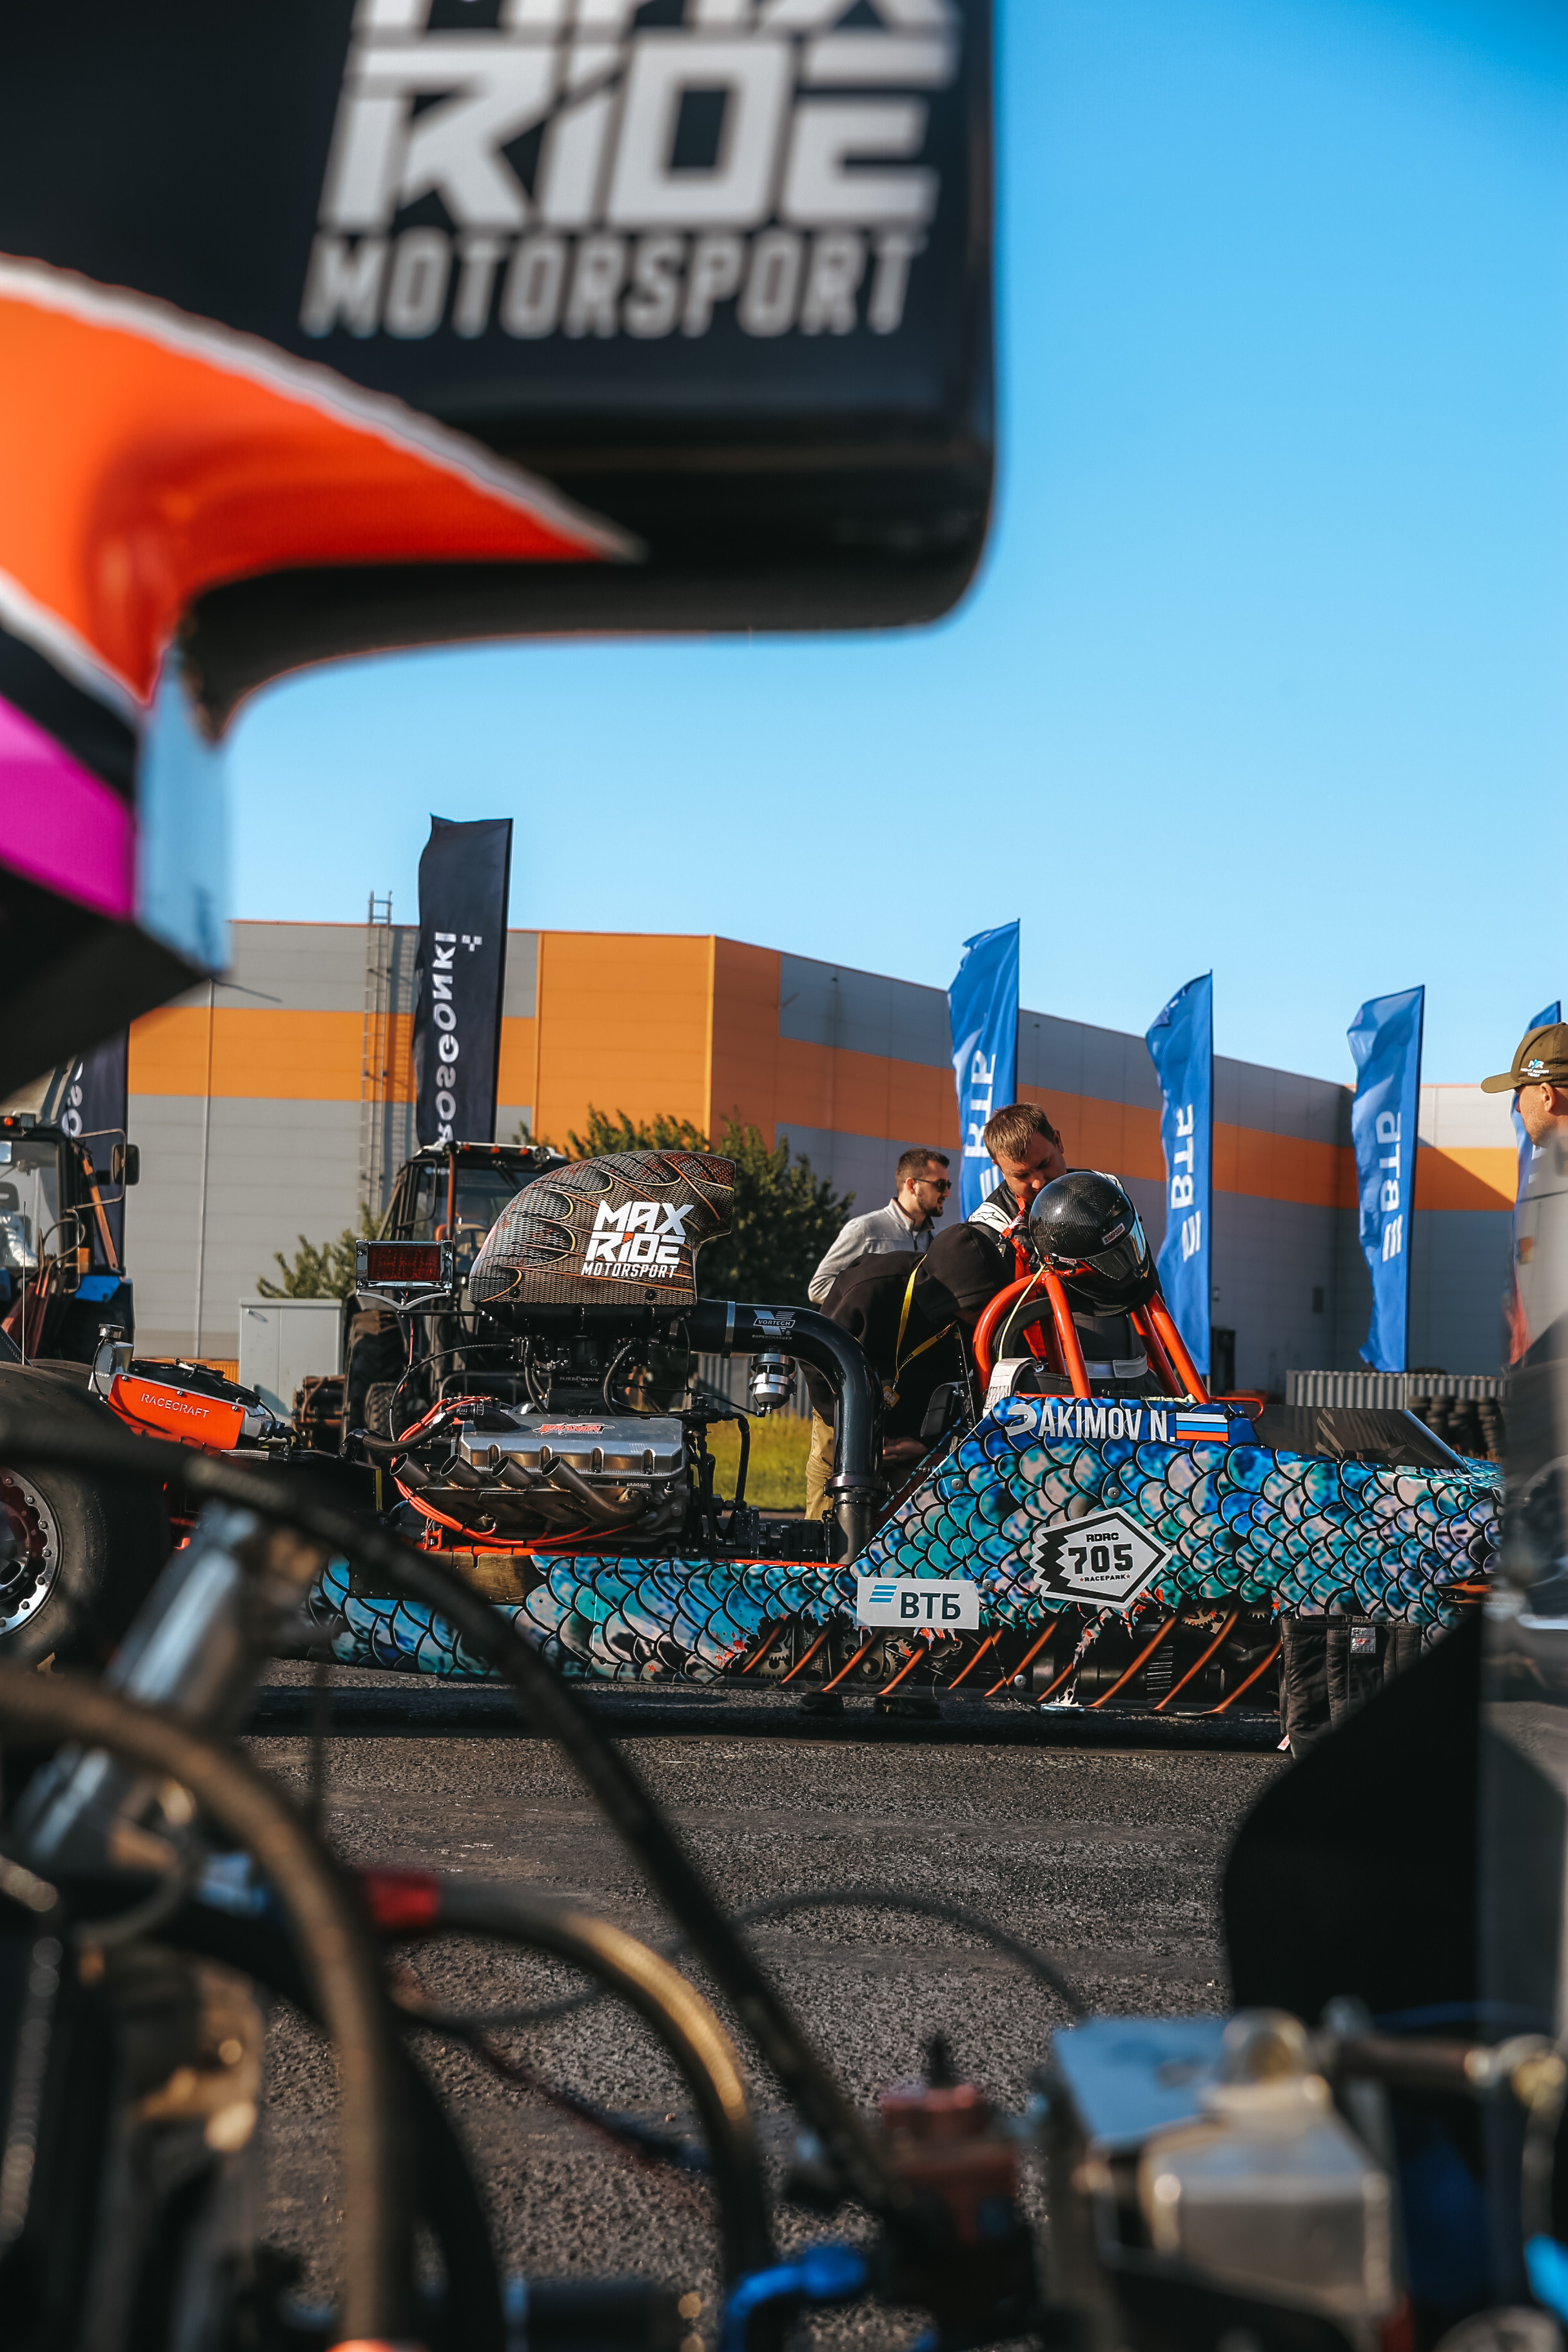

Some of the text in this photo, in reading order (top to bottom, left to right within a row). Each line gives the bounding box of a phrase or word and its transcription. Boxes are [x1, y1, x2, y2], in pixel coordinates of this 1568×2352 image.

[299, 228, 926, 338] MOTORSPORT
[593, 1200, 694, 1236] MAX
[1104, 1225, 1123, 1243] SIMPSON
[581, 1262, 678, 1278] MOTORSPORT
[141, 1393, 210, 1418] RACECRAFT
[1038, 1405, 1175, 1442] AKIMOV N.
[1086, 1533, 1119, 1542] RDRC
[1068, 1543, 1133, 1574] 705
[901, 1592, 961, 1620] ВТБ
